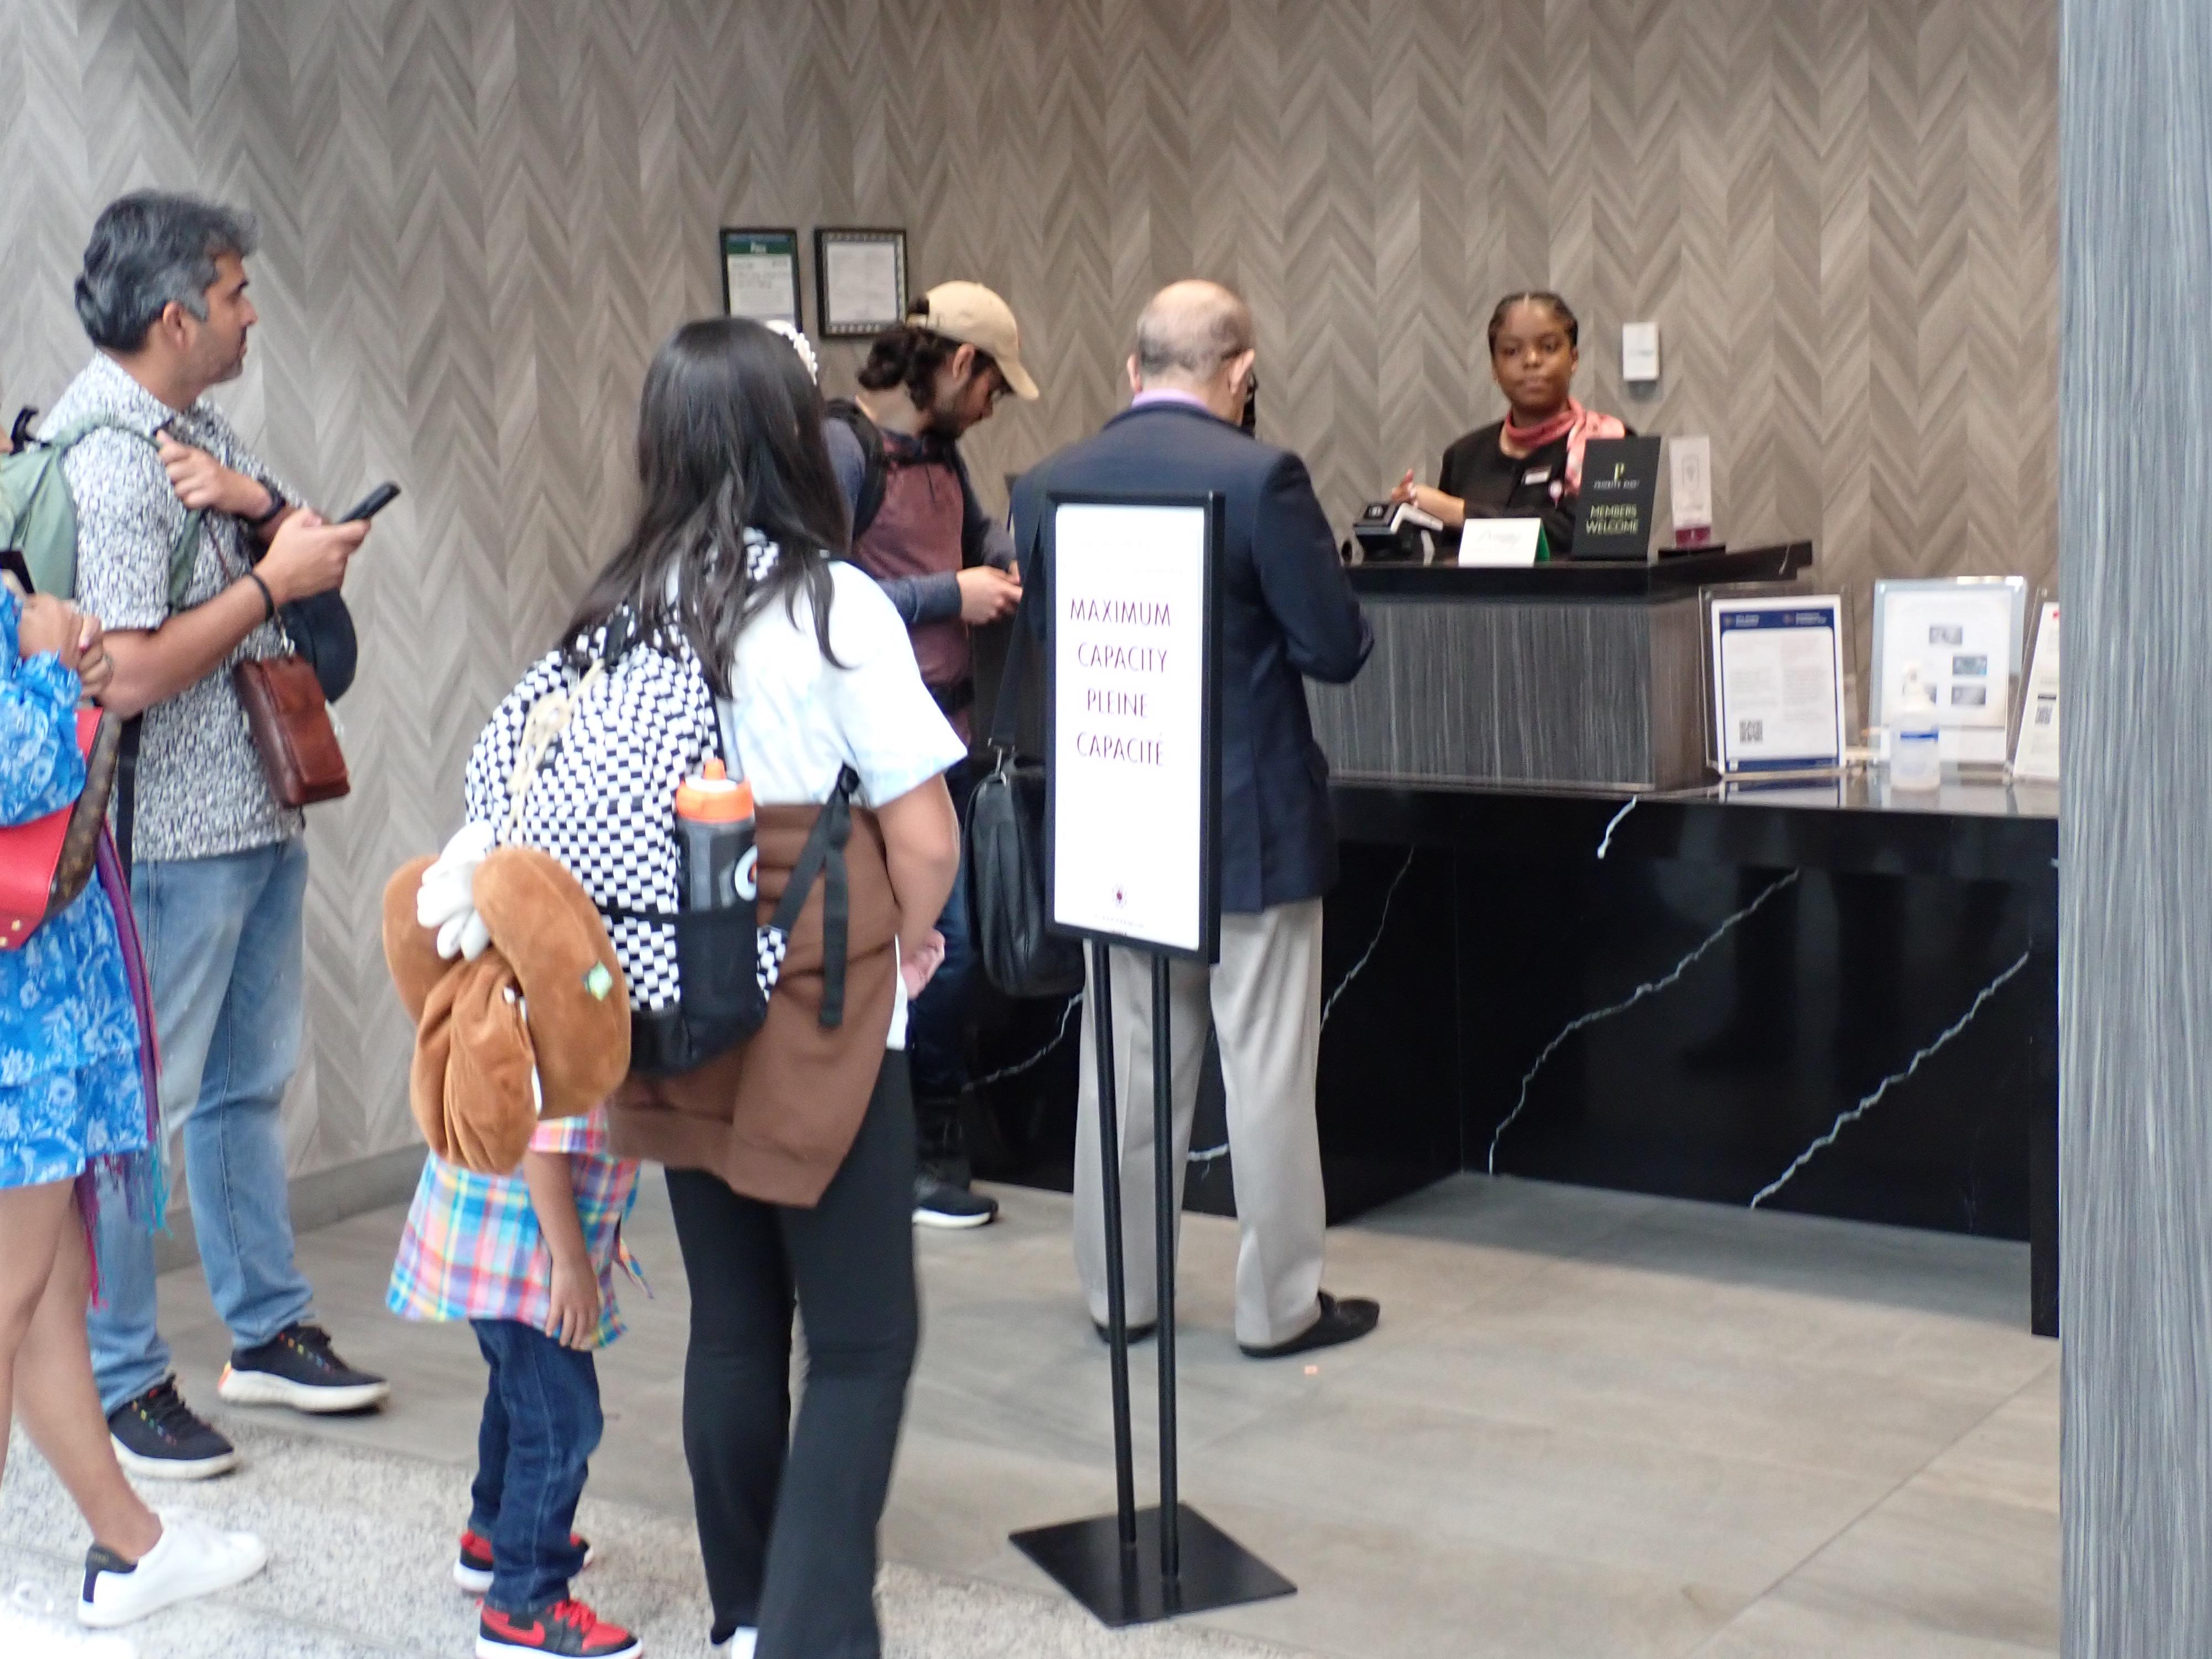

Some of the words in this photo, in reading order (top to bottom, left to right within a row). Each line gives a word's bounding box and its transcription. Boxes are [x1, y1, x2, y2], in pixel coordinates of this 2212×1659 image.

[1071, 598, 1170, 627] MAXIMUM
[1078, 642, 1167, 673] CAPACITY
[1088, 687, 1148, 718] PLEINE
[1077, 731, 1164, 767] CAPACITÉ
